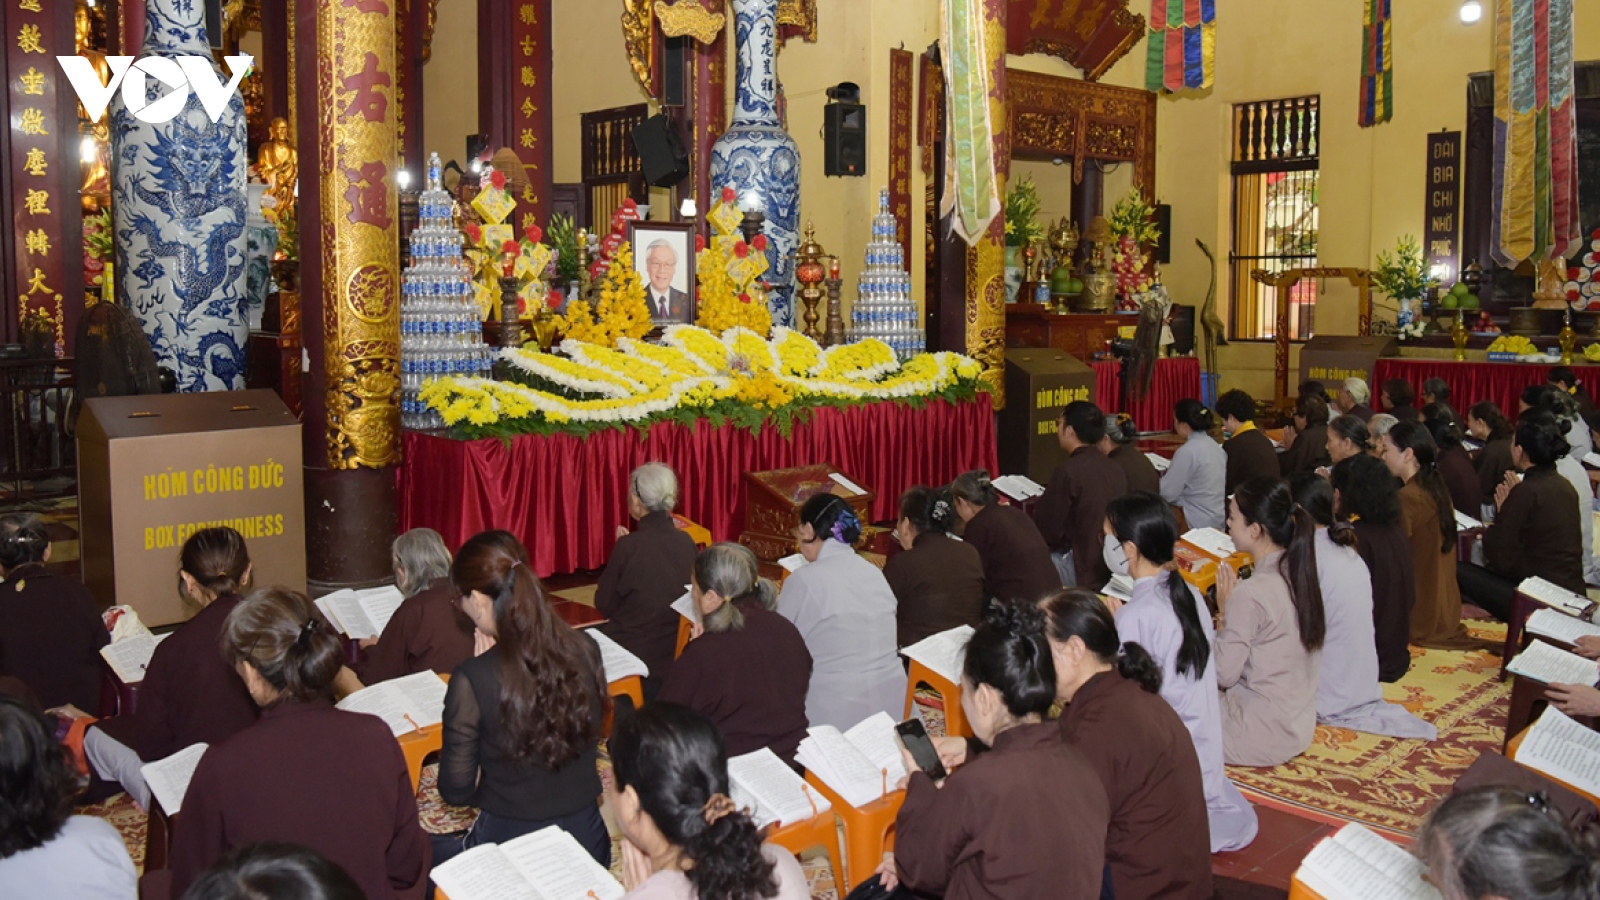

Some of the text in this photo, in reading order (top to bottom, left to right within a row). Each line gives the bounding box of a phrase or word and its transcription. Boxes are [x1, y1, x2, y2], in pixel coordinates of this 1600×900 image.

[1433, 166, 1454, 183] BIA
[1433, 190, 1453, 208] GHI
[193, 463, 244, 495] CÔNG
[248, 457, 284, 491] ĐỨC
[144, 524, 175, 550] BOX
[177, 521, 207, 547] FO
